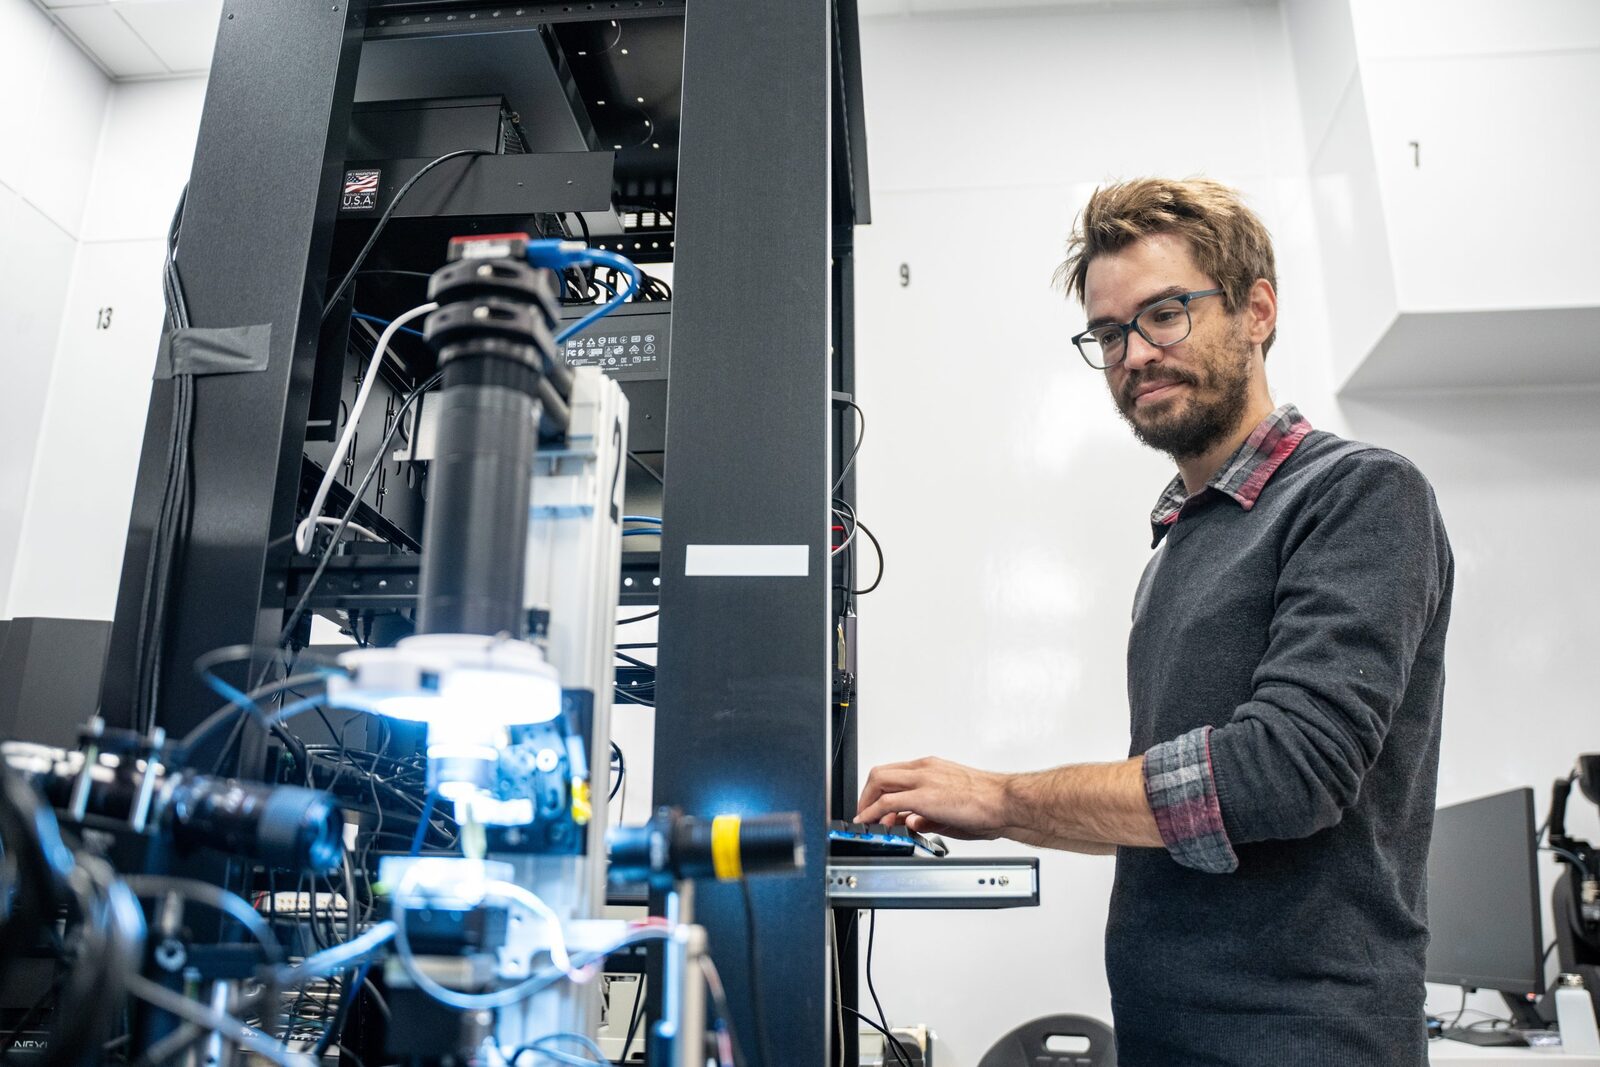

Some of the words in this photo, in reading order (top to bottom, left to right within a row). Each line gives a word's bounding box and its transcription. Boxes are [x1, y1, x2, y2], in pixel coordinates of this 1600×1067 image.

[343, 195, 374, 205] U.S.A.
[899, 262, 910, 288] 9
[96, 306, 113, 330] 13
